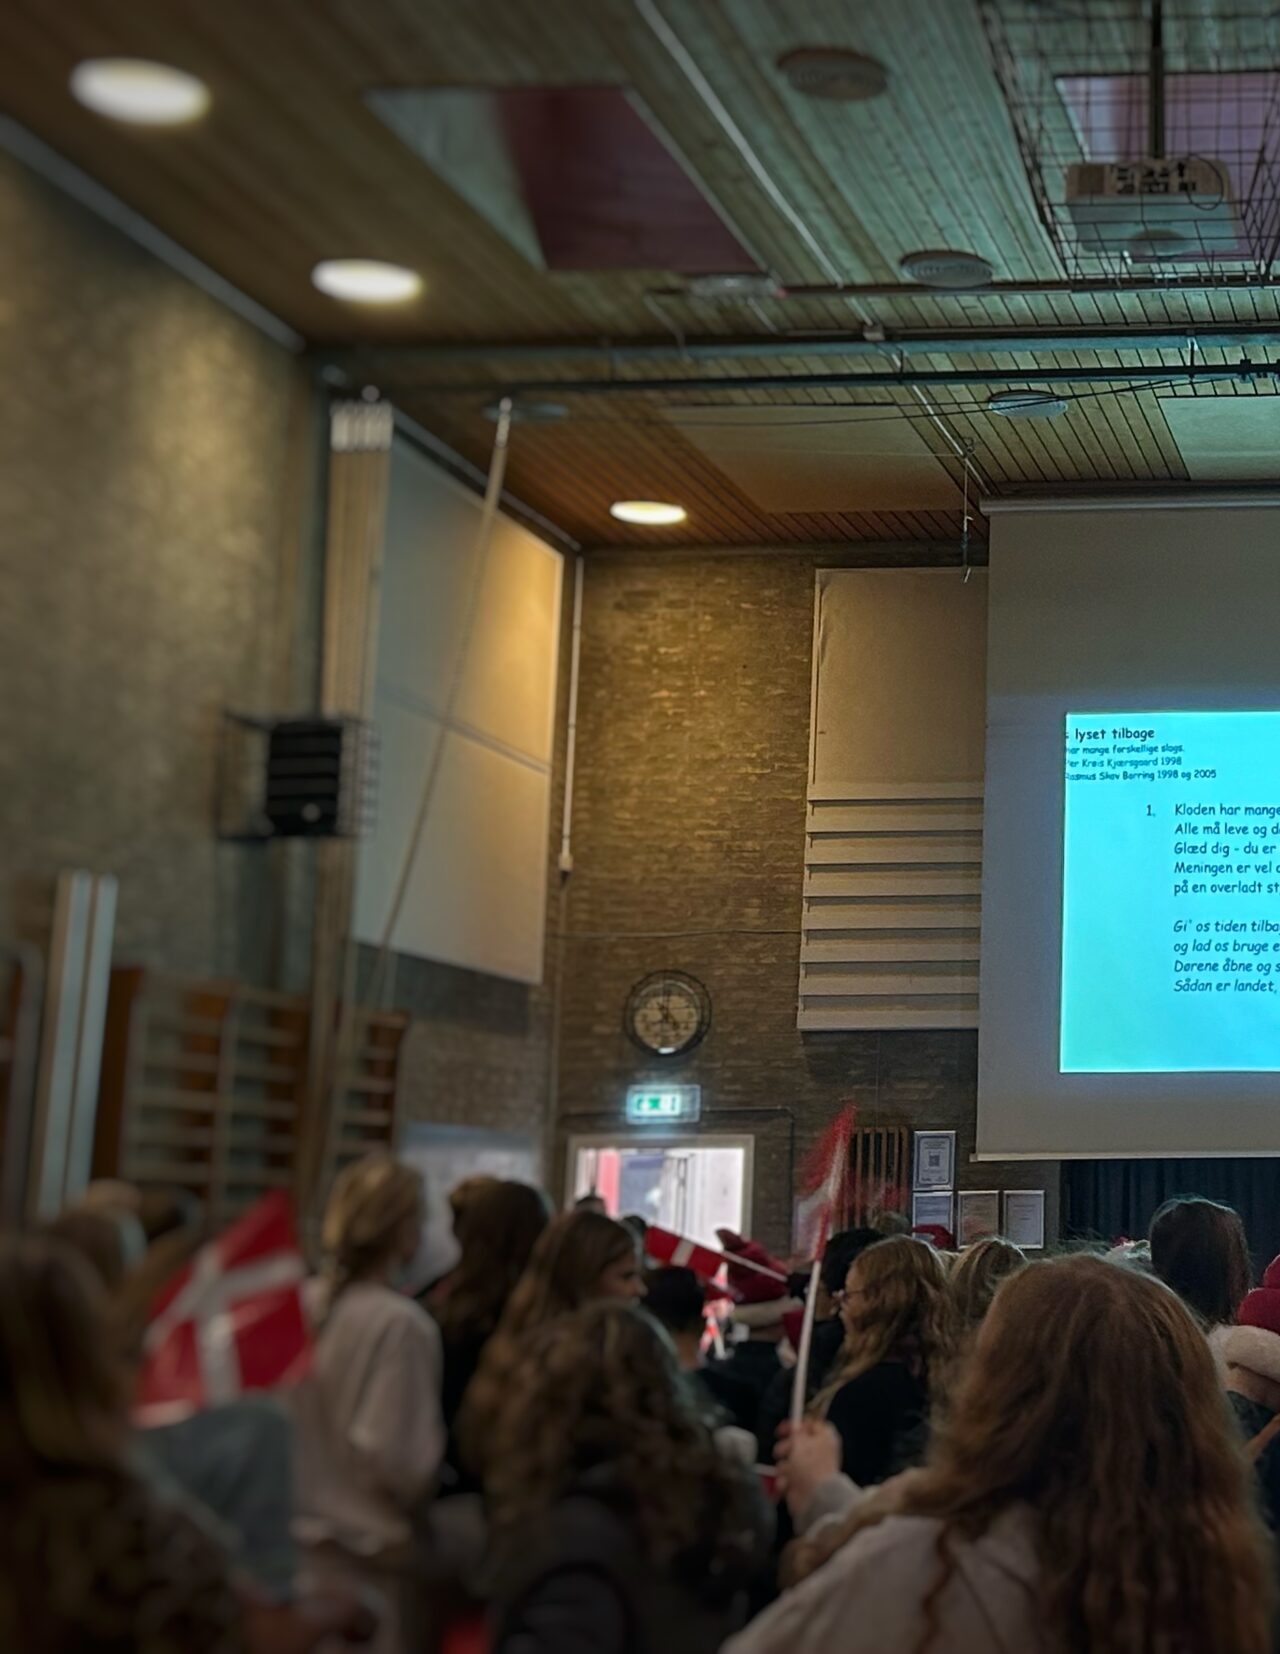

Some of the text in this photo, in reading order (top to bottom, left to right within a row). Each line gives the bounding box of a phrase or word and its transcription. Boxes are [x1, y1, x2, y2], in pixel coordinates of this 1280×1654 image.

[1075, 727, 1106, 743] lyset
[1112, 727, 1155, 742] tilbage
[1082, 747, 1110, 756] mange
[1112, 744, 1159, 755] forskellige
[1161, 756, 1182, 766] 1998
[1157, 769, 1179, 779] 1998
[1180, 772, 1192, 781] og
[1193, 769, 1217, 779] 2005
[1146, 804, 1156, 818] 1.
[1174, 803, 1216, 817] Kloden
[1219, 803, 1241, 816] har
[1174, 822, 1199, 836] Alle
[1202, 821, 1221, 836] må
[1224, 822, 1249, 836] leve
[1252, 825, 1268, 838] og
[1174, 842, 1207, 855] Glæd
[1210, 842, 1230, 858] dig
[1243, 841, 1259, 855] du
[1262, 844, 1277, 855] er
[1174, 862, 1233, 877] Meningen
[1236, 864, 1251, 874] er
[1254, 861, 1272, 874] vel
[1173, 879, 1189, 896] på
[1192, 883, 1207, 893] en
[1210, 880, 1264, 894] overladt
[1195, 922, 1211, 933] os
[1214, 919, 1247, 933] tiden
[1173, 942, 1189, 955] og
[1191, 939, 1212, 952] lad
[1214, 942, 1229, 952] os
[1232, 939, 1269, 956] bruge
[1174, 960, 1219, 973] Dørene
[1222, 957, 1253, 973] åbne
[1256, 961, 1272, 975] og
[1173, 977, 1213, 992] Sådan
[1215, 982, 1231, 992] er
[1234, 978, 1278, 995] landet,
